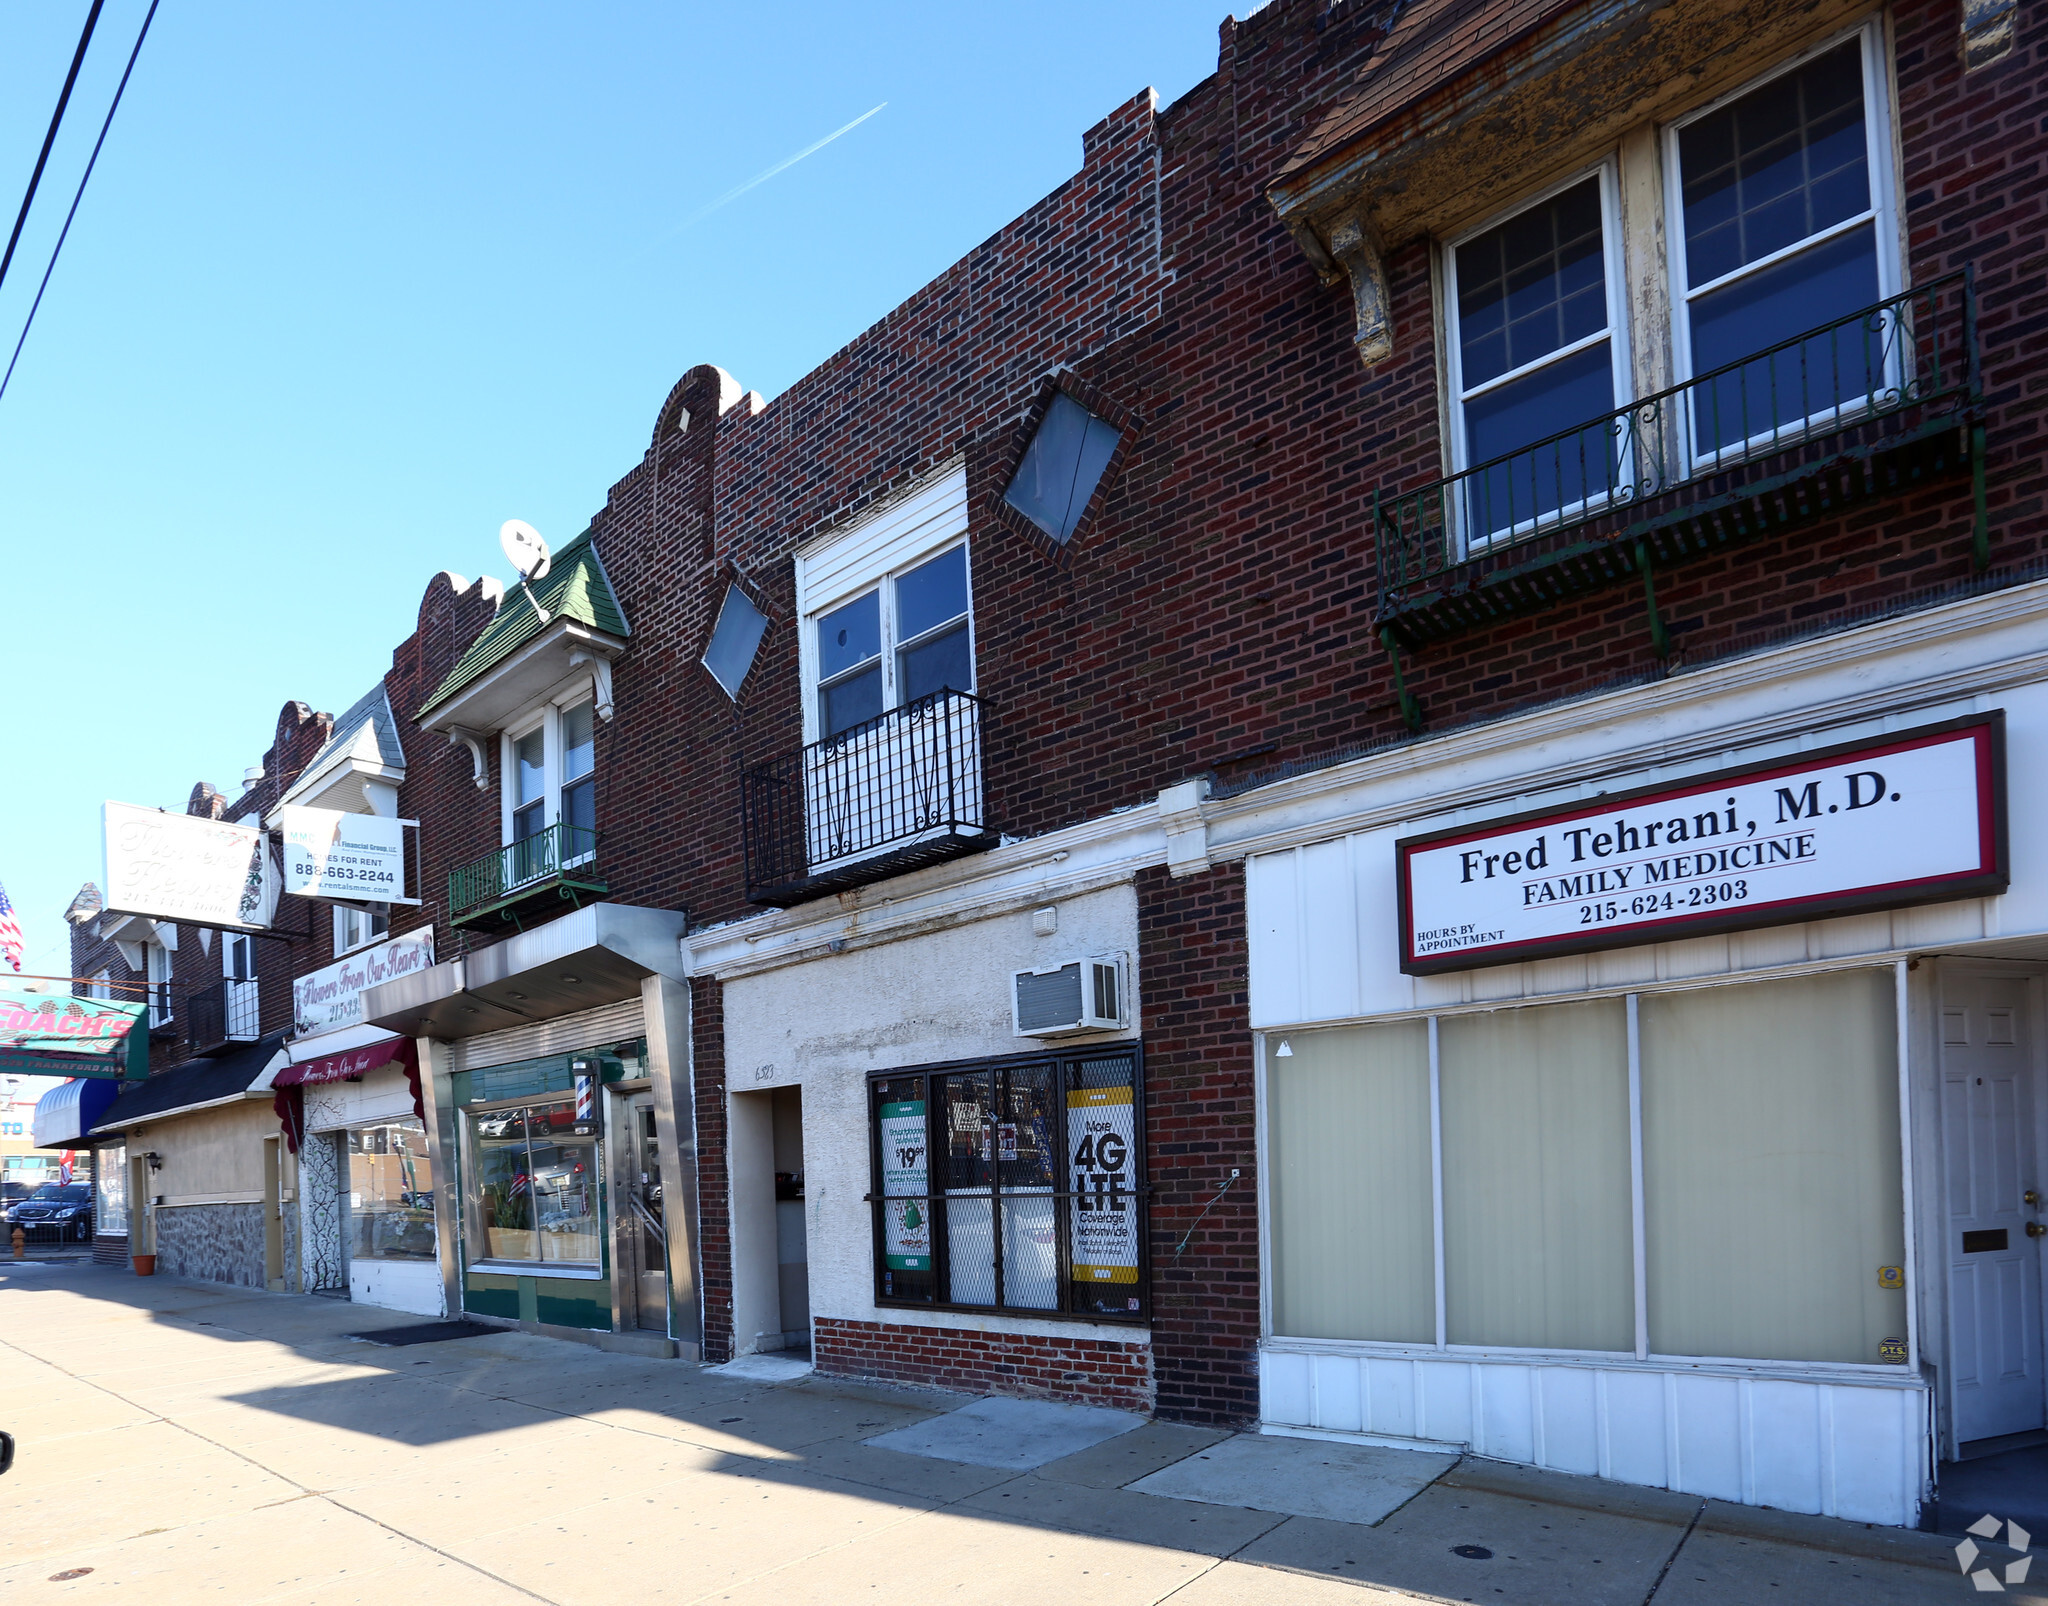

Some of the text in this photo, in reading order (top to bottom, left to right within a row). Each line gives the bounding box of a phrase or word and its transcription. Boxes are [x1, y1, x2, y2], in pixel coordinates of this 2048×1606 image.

[1459, 771, 1901, 884] Fred Tehrani, M.D.
[342, 841, 369, 850] Financial
[341, 855, 357, 865] FOR
[360, 858, 383, 867] RENT
[1523, 834, 1817, 906] FAMILY MEDICINE
[296, 863, 394, 883] 888-663-2244
[303, 880, 389, 894] w.rentalsmmc.com
[1580, 880, 1748, 925] 215-624-2303
[1418, 924, 1476, 942] HOURS BY
[1418, 930, 1506, 953] APPOINTMENT
[303, 943, 420, 1007] Flowers From Our Heart
[27, 1060, 99, 1072] FRANKFORD
[1086, 1121, 1112, 1132] More
[1075, 1133, 1126, 1172] 4G
[1078, 1174, 1126, 1212] LTE
[1080, 1212, 1125, 1226] Coverage
[1077, 1226, 1129, 1238] Nationwide
